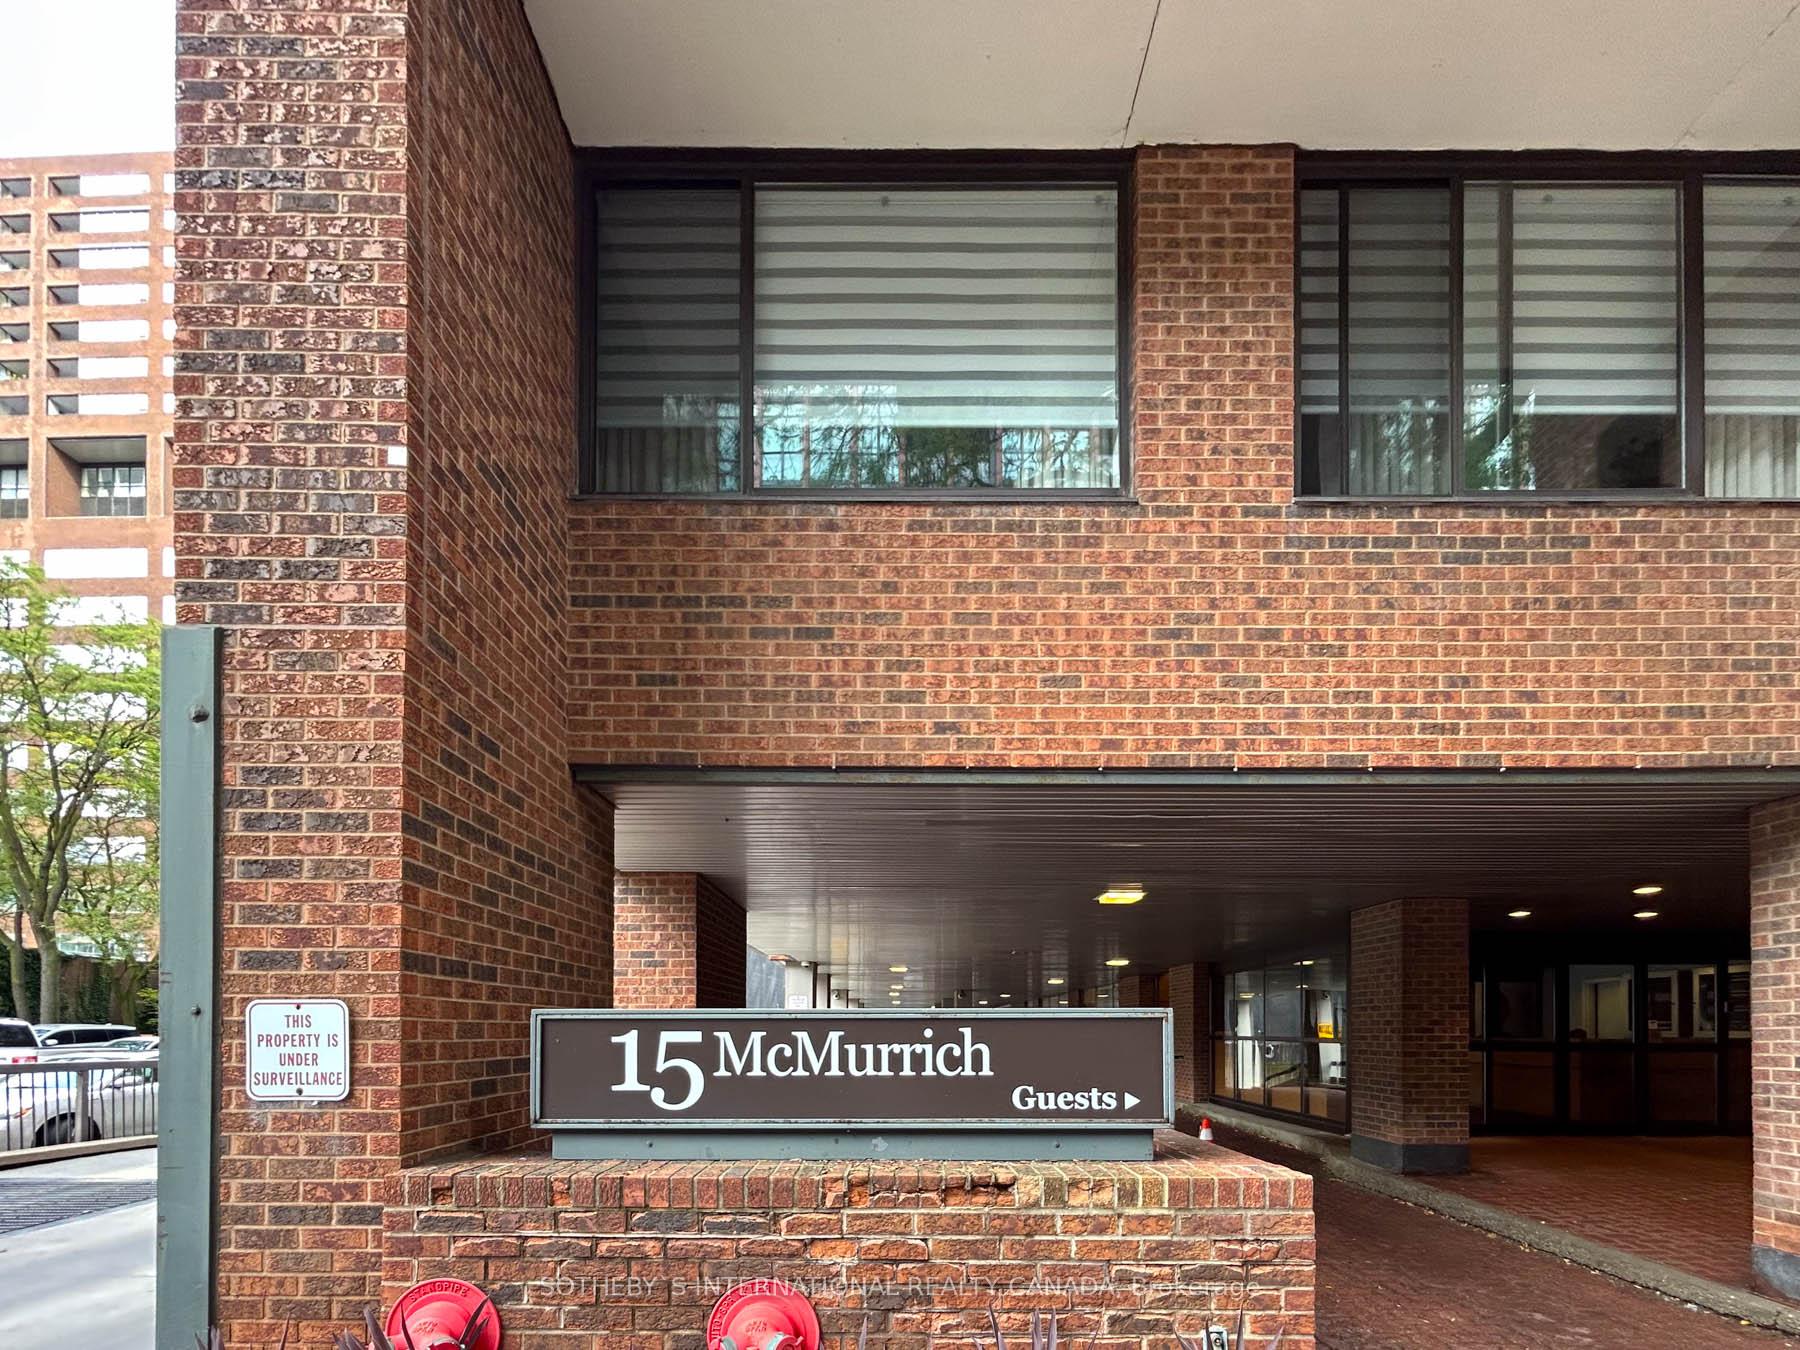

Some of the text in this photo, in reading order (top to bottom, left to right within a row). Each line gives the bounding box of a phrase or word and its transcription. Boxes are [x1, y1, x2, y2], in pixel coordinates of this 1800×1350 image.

[284, 1014, 312, 1028] THIS
[257, 1033, 339, 1047] PROPERTY IS
[279, 1052, 319, 1067] UNDER
[610, 1027, 995, 1111] 15 McMurrich
[253, 1071, 343, 1086] SURVEILLANCE
[1011, 1085, 1118, 1110] Guests
[408, 1281, 471, 1303] STANDPIPE
